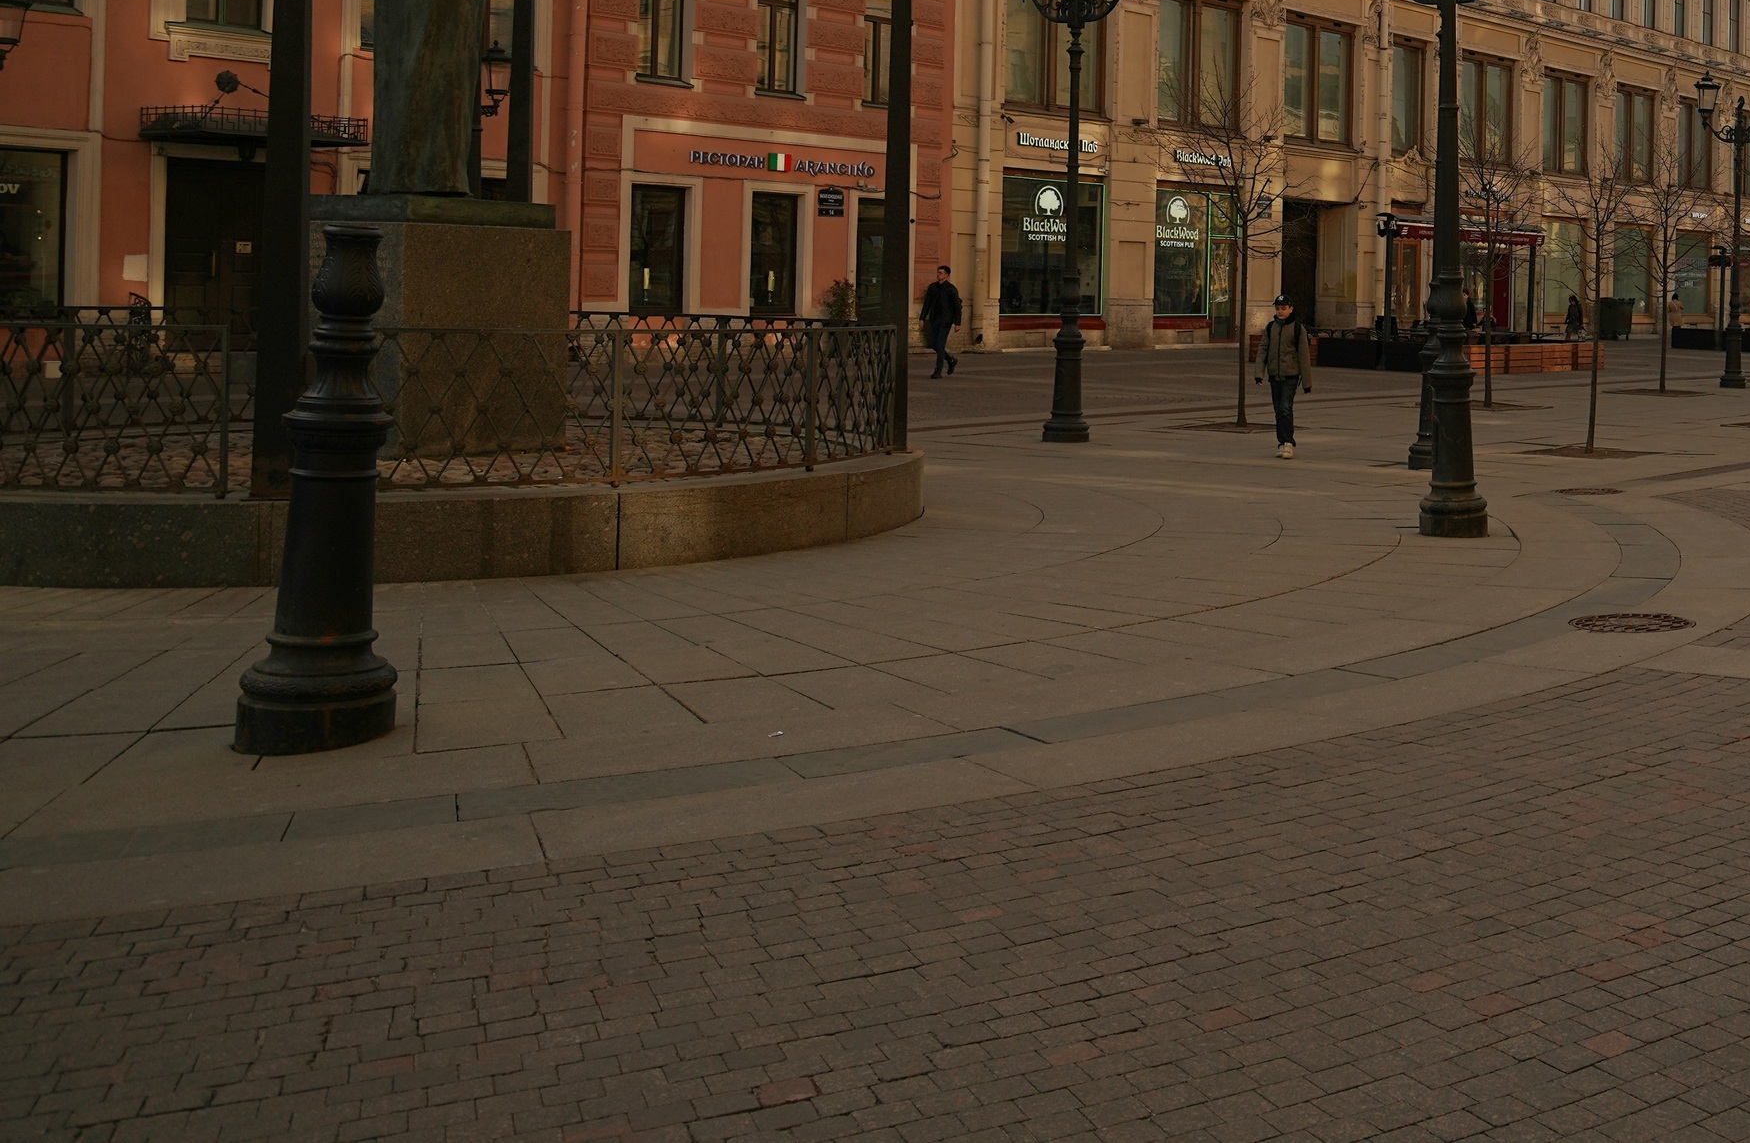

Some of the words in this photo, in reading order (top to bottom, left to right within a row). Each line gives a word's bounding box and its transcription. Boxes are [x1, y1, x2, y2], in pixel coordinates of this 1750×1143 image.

[1018, 132, 1069, 151] Шотландск
[1081, 140, 1098, 154] Паб
[690, 150, 765, 169] РЕСТОРАН
[1218, 155, 1232, 167] Pub
[1027, 233, 1057, 242] SCOTTISH
[1057, 234, 1067, 242] PU
[1156, 225, 1199, 241] BlackWood
[1160, 240, 1184, 248] SCOTTISH
[1184, 241, 1195, 249] PUB
